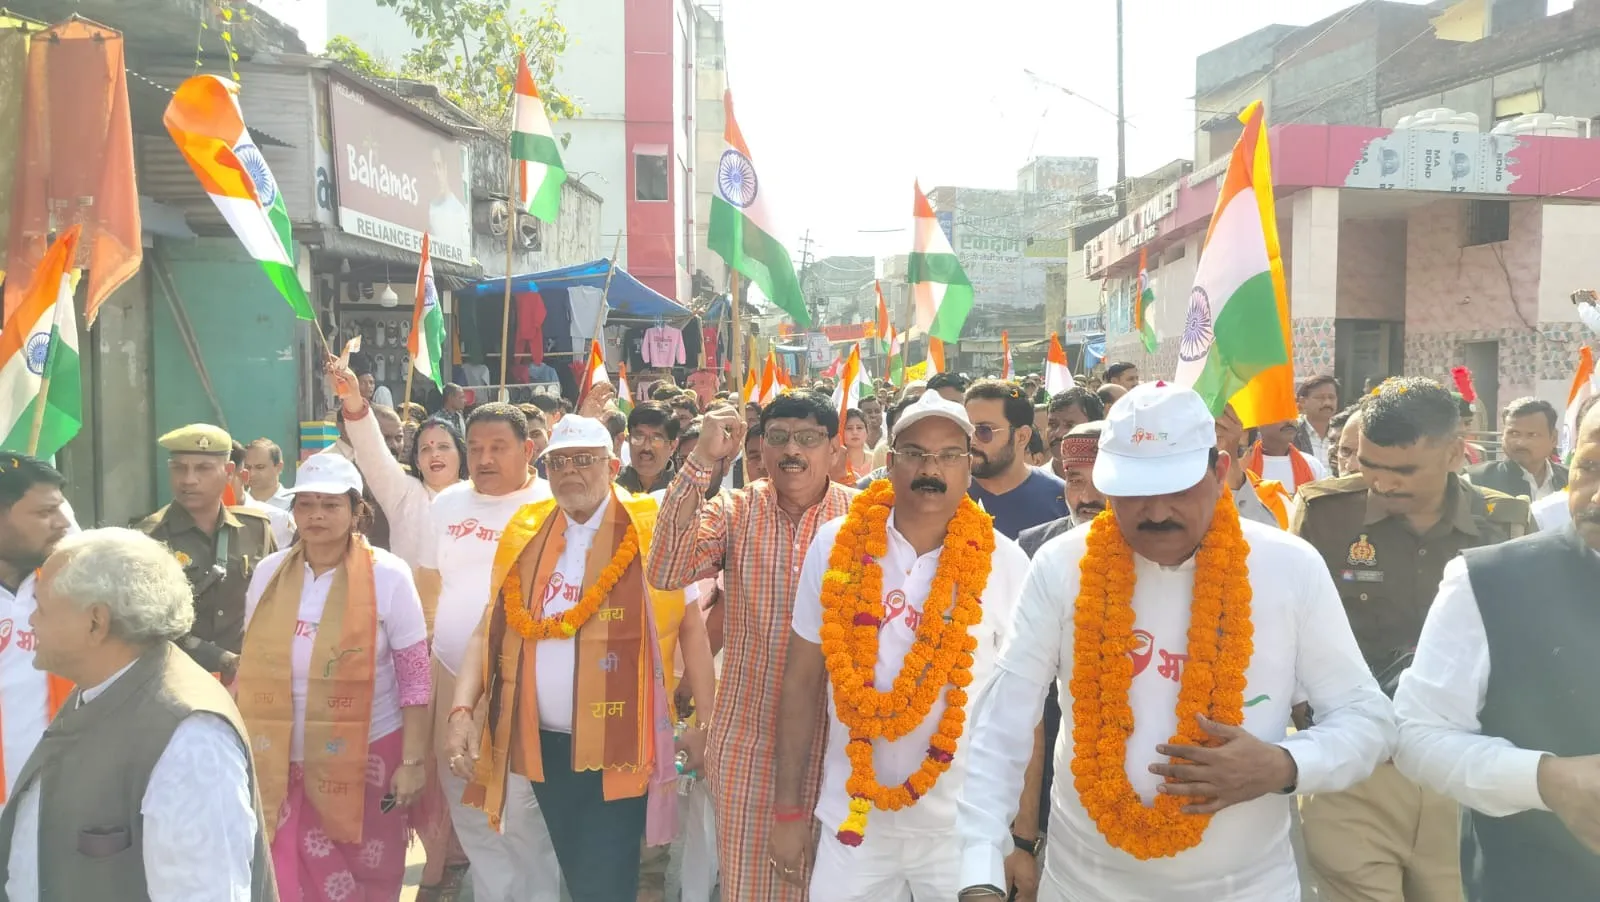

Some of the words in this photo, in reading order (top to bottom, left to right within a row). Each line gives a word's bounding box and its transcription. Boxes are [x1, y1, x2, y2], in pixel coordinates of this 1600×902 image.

[346, 143, 419, 206] Bahamas
[356, 217, 411, 247] RELIANCE
[589, 701, 626, 719] राम
